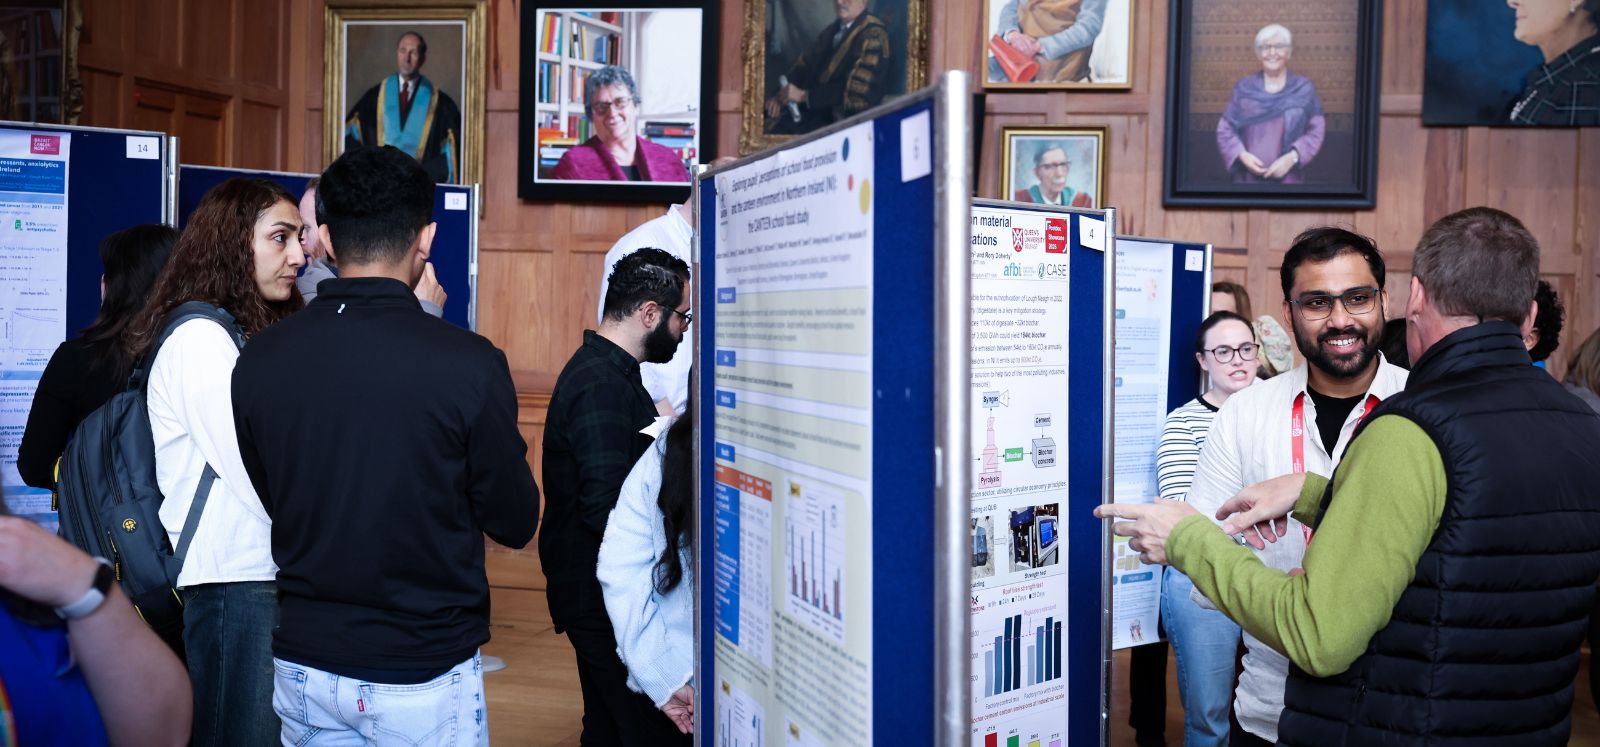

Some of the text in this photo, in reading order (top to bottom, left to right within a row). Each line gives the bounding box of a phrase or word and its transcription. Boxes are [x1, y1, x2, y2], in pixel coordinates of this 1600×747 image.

[137, 144, 148, 153] 14
[28, 161, 59, 170] anxiolytics
[814, 151, 837, 170] provision
[756, 192, 780, 208] environment
[786, 185, 806, 200] Northern
[754, 215, 771, 232] CANTEEN
[980, 215, 1012, 228] material
[1048, 233, 1065, 241] Showcase
[1089, 228, 1094, 240] 4
[1192, 256, 1196, 265] 2
[1003, 262, 1022, 277] afbi
[1046, 263, 1067, 277] CASE
[983, 395, 998, 403] Syngas
[980, 475, 1000, 485] Pyrolysis
